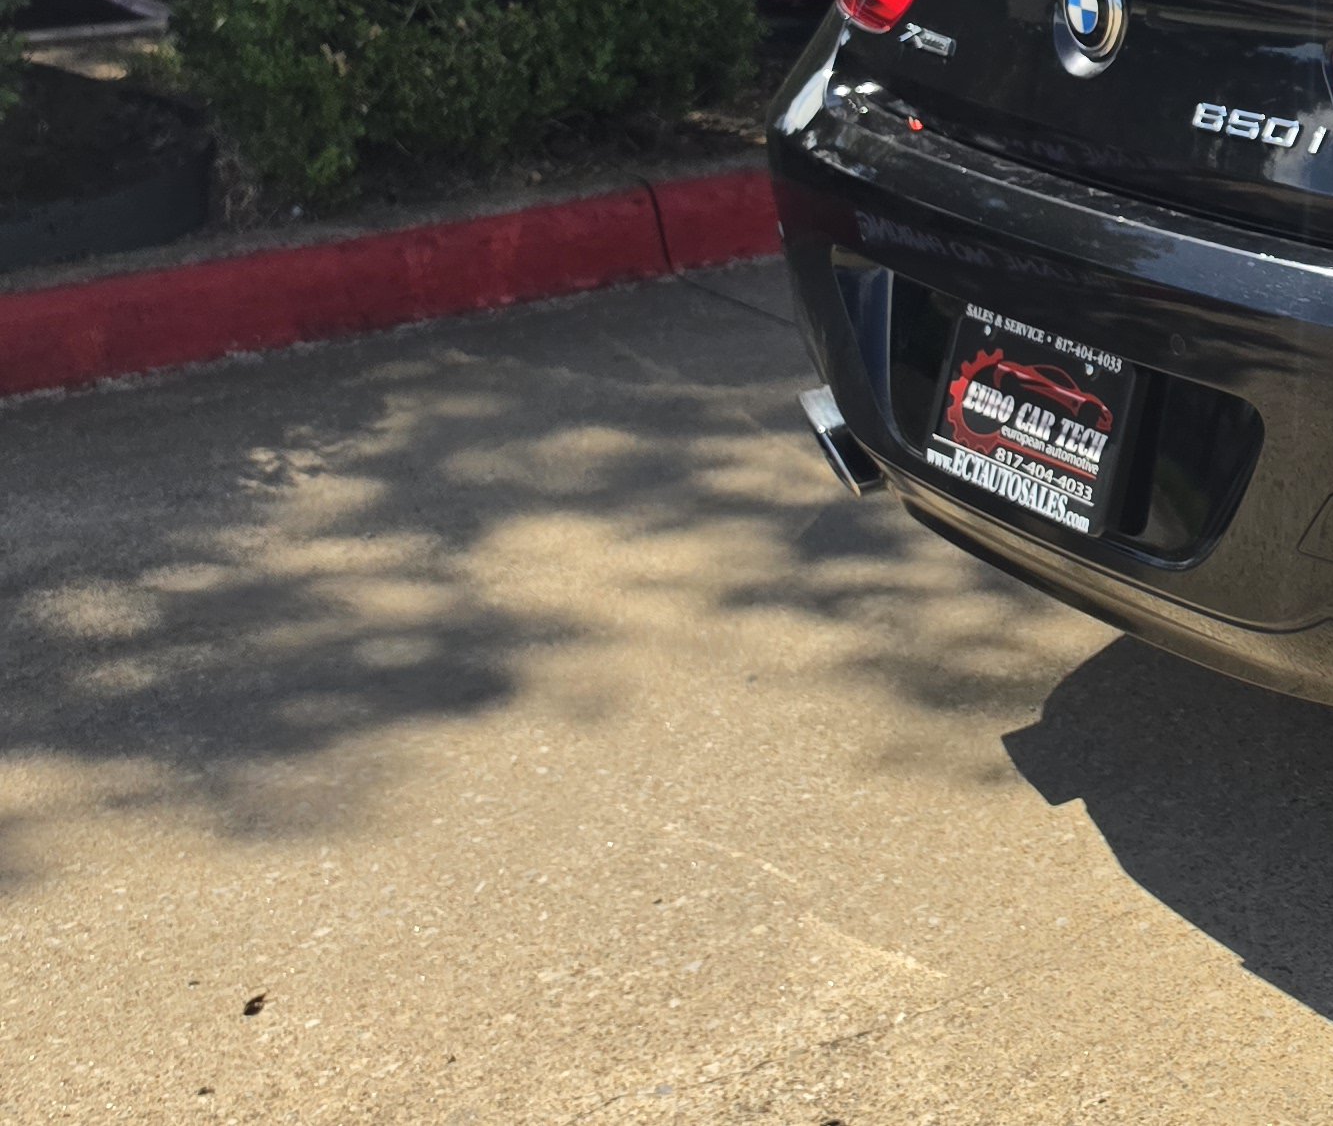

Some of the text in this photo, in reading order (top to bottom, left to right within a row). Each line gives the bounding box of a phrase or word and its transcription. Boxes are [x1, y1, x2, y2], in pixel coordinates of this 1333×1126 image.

[966, 302, 1123, 374] SALES & SERVICE 817-404-4033
[962, 380, 1109, 464] EURO CAR TECH
[1001, 425, 1100, 475] european automotive
[926, 447, 1090, 534] www.ECTAUTOSALES.com
[994, 447, 1094, 501] 817-404-4033
